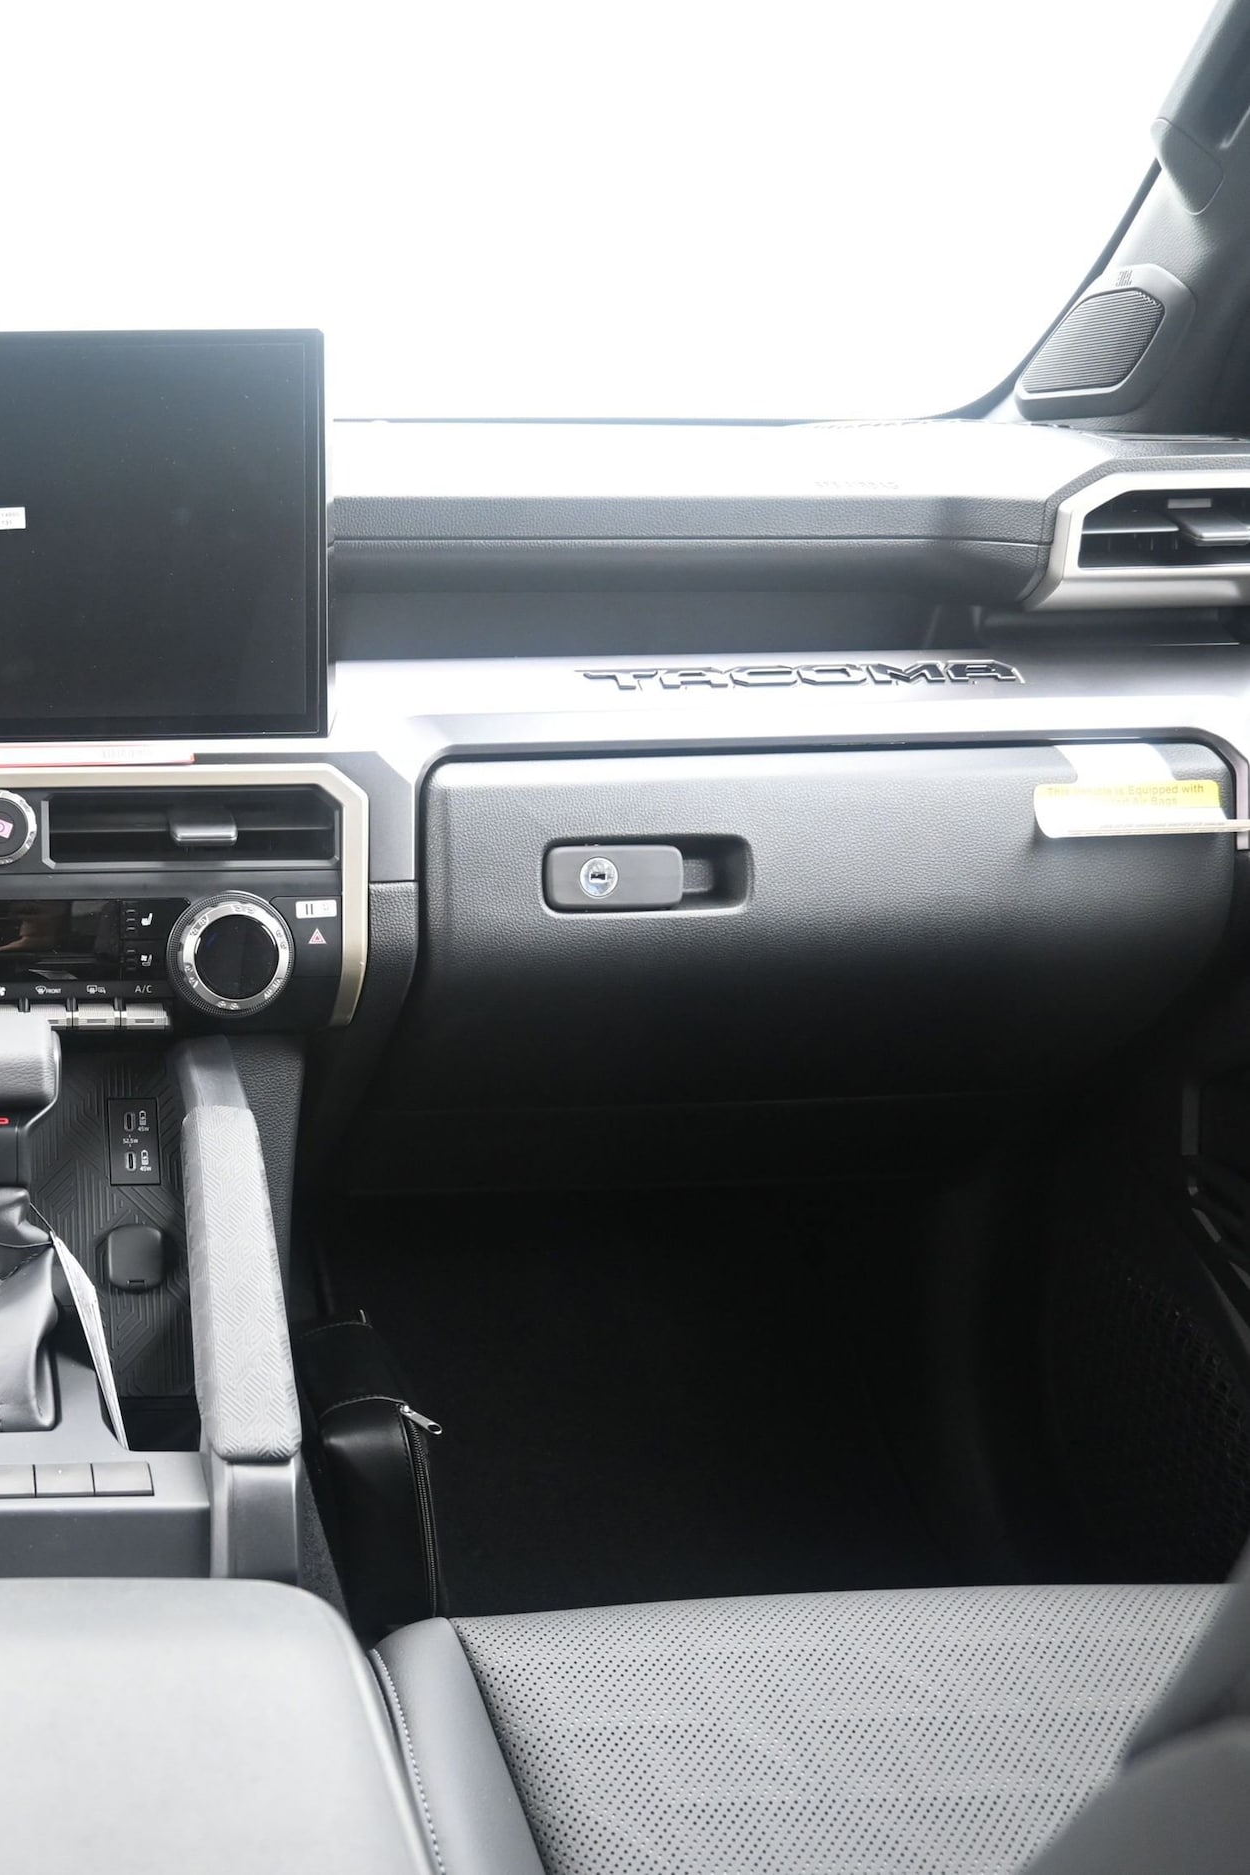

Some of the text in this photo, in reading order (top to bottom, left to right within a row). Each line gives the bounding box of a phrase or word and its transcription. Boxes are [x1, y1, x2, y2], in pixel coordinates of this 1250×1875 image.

[576, 659, 1022, 691] TACOMA
[1128, 784, 1179, 798] Equipped
[1182, 783, 1205, 794] with
[134, 985, 153, 993] A/C
